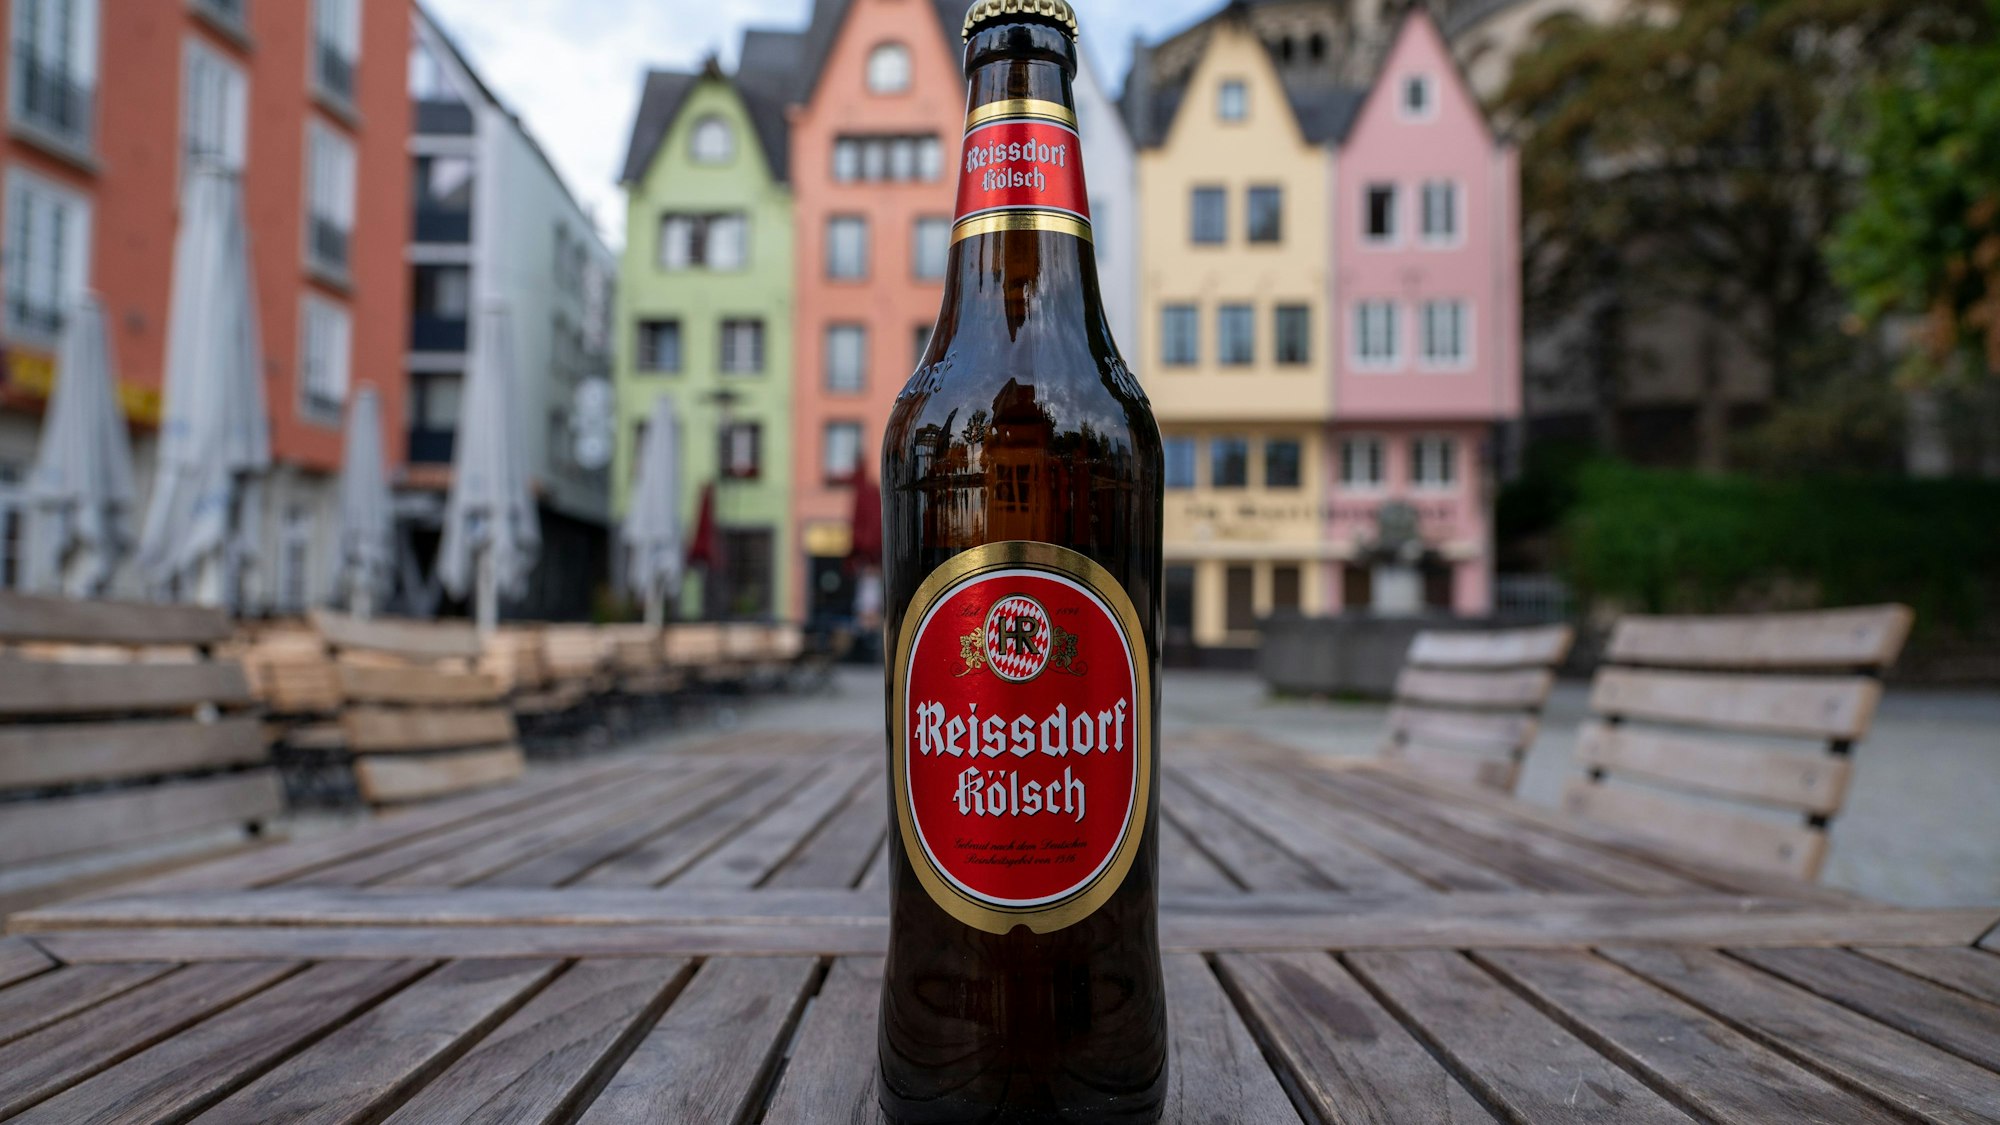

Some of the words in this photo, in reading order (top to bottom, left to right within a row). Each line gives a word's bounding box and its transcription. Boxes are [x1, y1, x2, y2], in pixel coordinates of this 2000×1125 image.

[966, 138, 1066, 173] Reissdorf
[982, 166, 1046, 192] Kölsch
[998, 615, 1041, 656] HR
[914, 697, 1128, 759] Reissdorf
[953, 765, 1087, 823] Kölsch
[990, 839, 1016, 851] nach
[1016, 840, 1037, 851] dem
